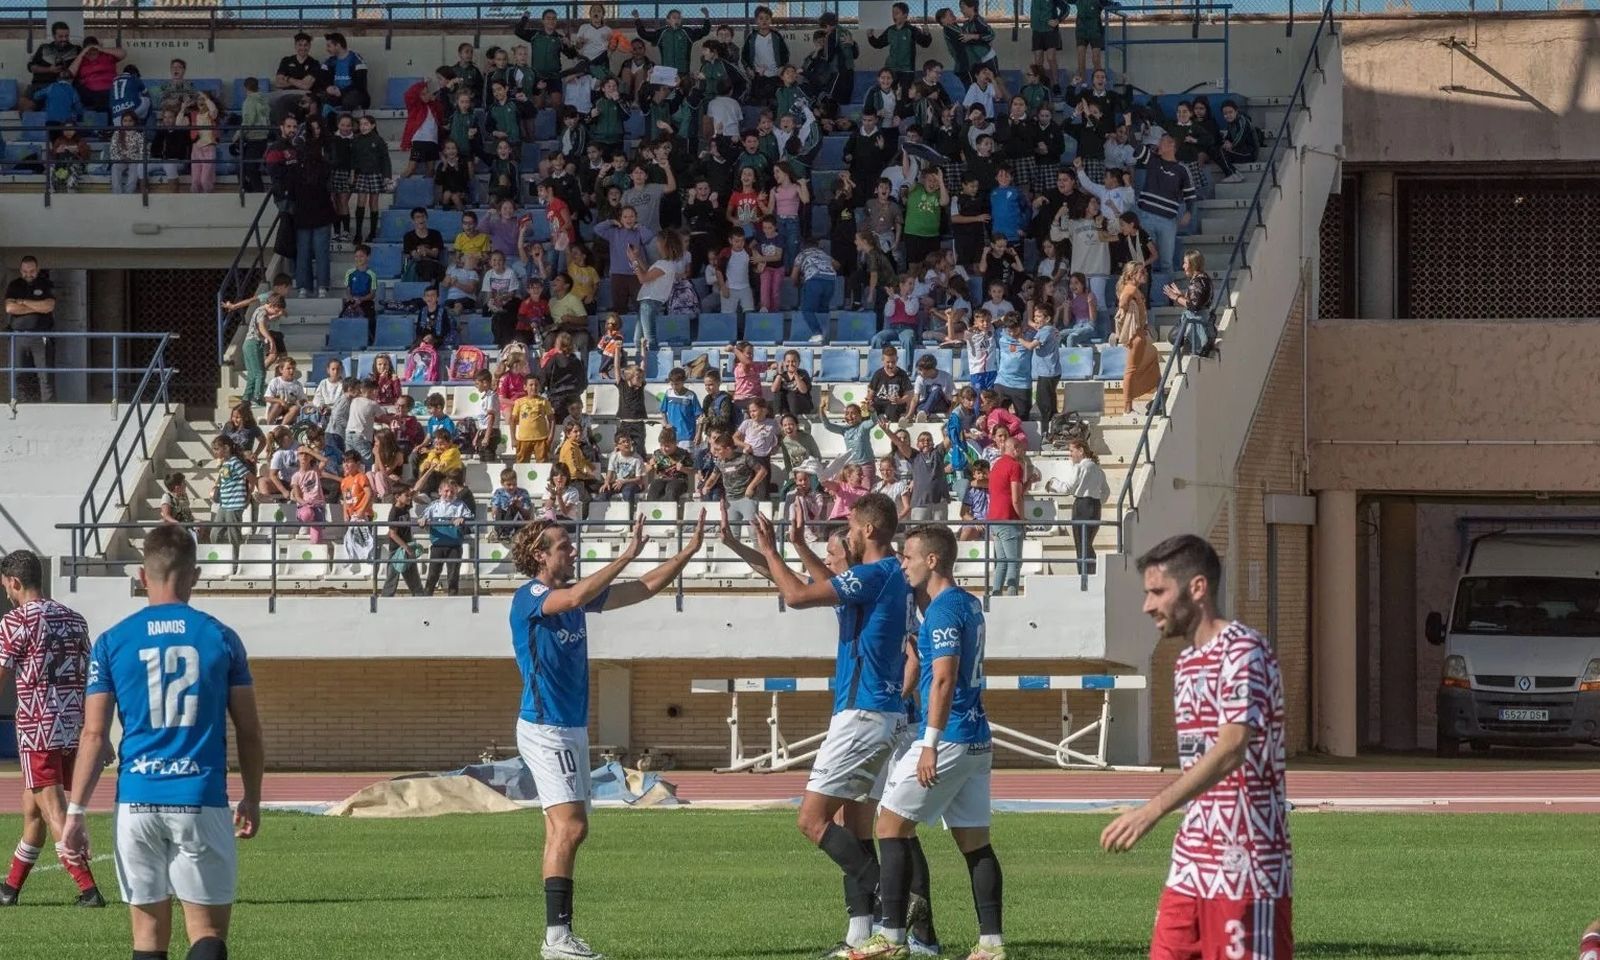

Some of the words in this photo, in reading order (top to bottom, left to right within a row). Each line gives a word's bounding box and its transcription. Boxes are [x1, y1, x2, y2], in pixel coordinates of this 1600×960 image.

[113, 79, 128, 100] 17
[147, 619, 186, 636] RAMOS
[932, 627, 959, 643] SYC
[139, 645, 200, 729] 12
[1504, 711, 1528, 719] 5527
[151, 759, 200, 775] PLAZA
[554, 748, 577, 775] 10
[1224, 918, 1246, 960] 3
